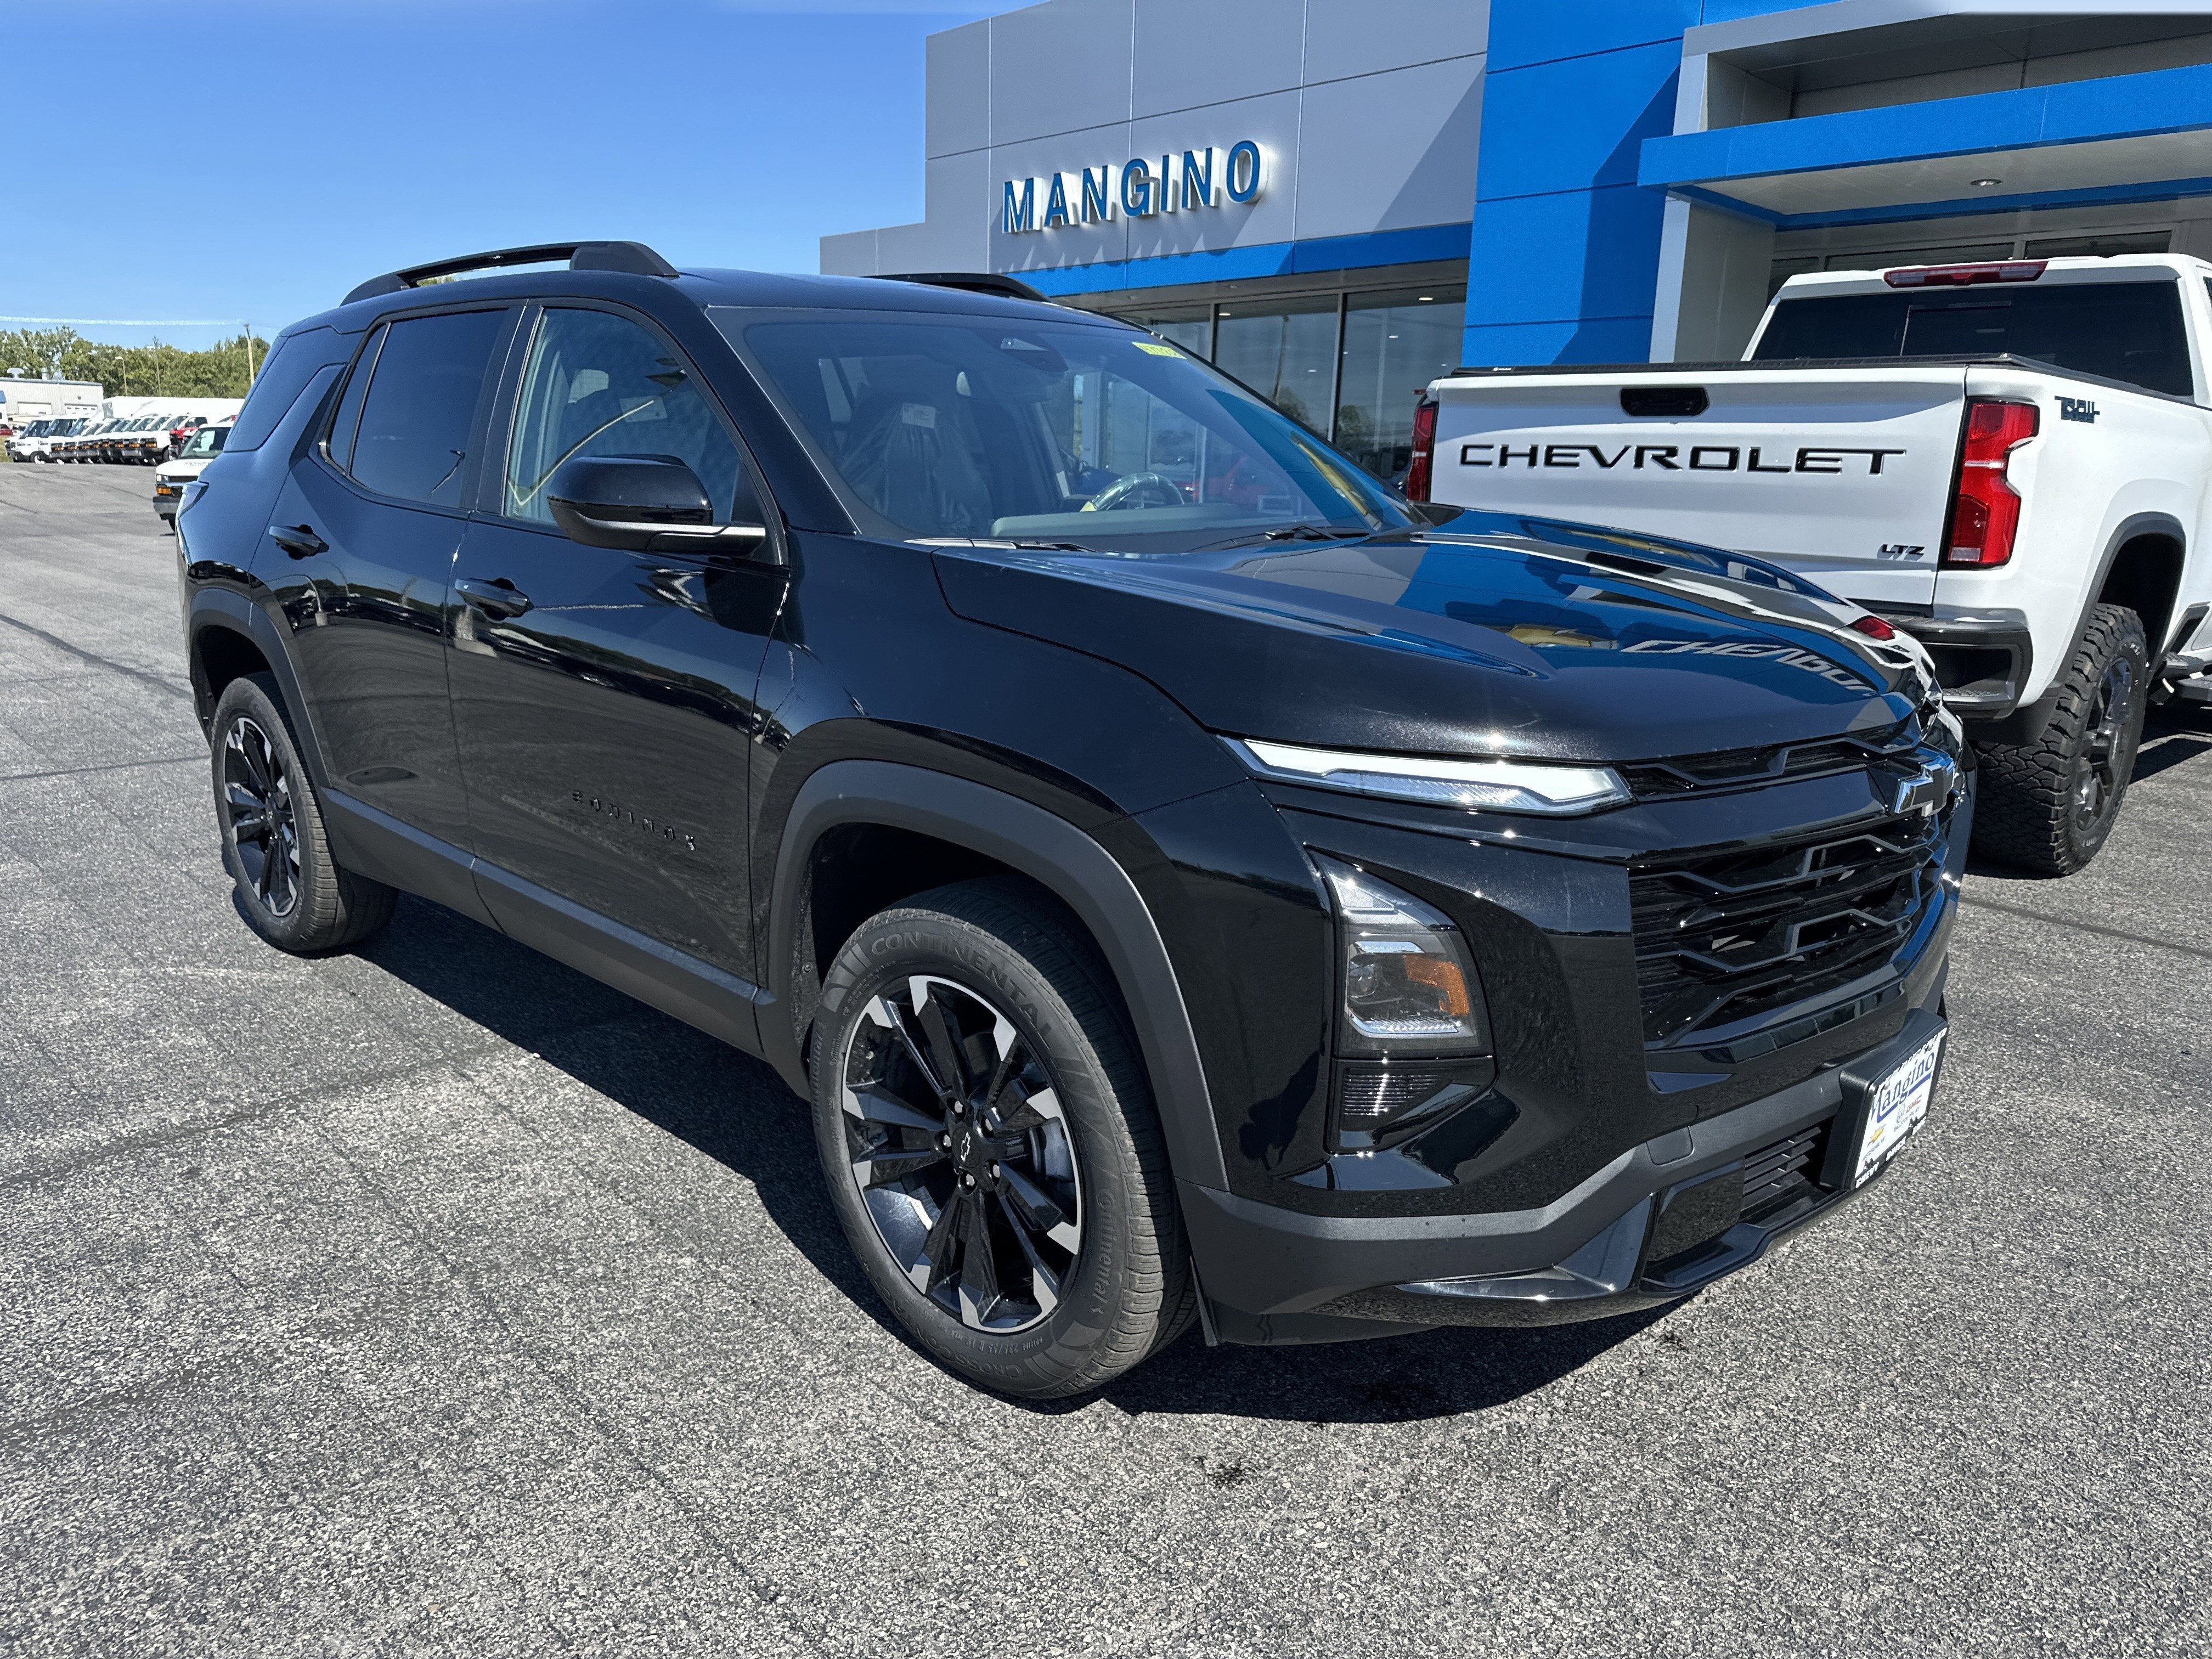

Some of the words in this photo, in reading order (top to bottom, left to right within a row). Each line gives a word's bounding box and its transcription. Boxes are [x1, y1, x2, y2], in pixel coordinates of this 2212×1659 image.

[1002, 139, 1268, 234] MANGINO
[1459, 443, 1906, 475] CHEVROLET
[1881, 544, 1925, 555] LTZ
[871, 931, 1052, 1050] CONTINENTAL
[1870, 1051, 1935, 1124] Mangino
